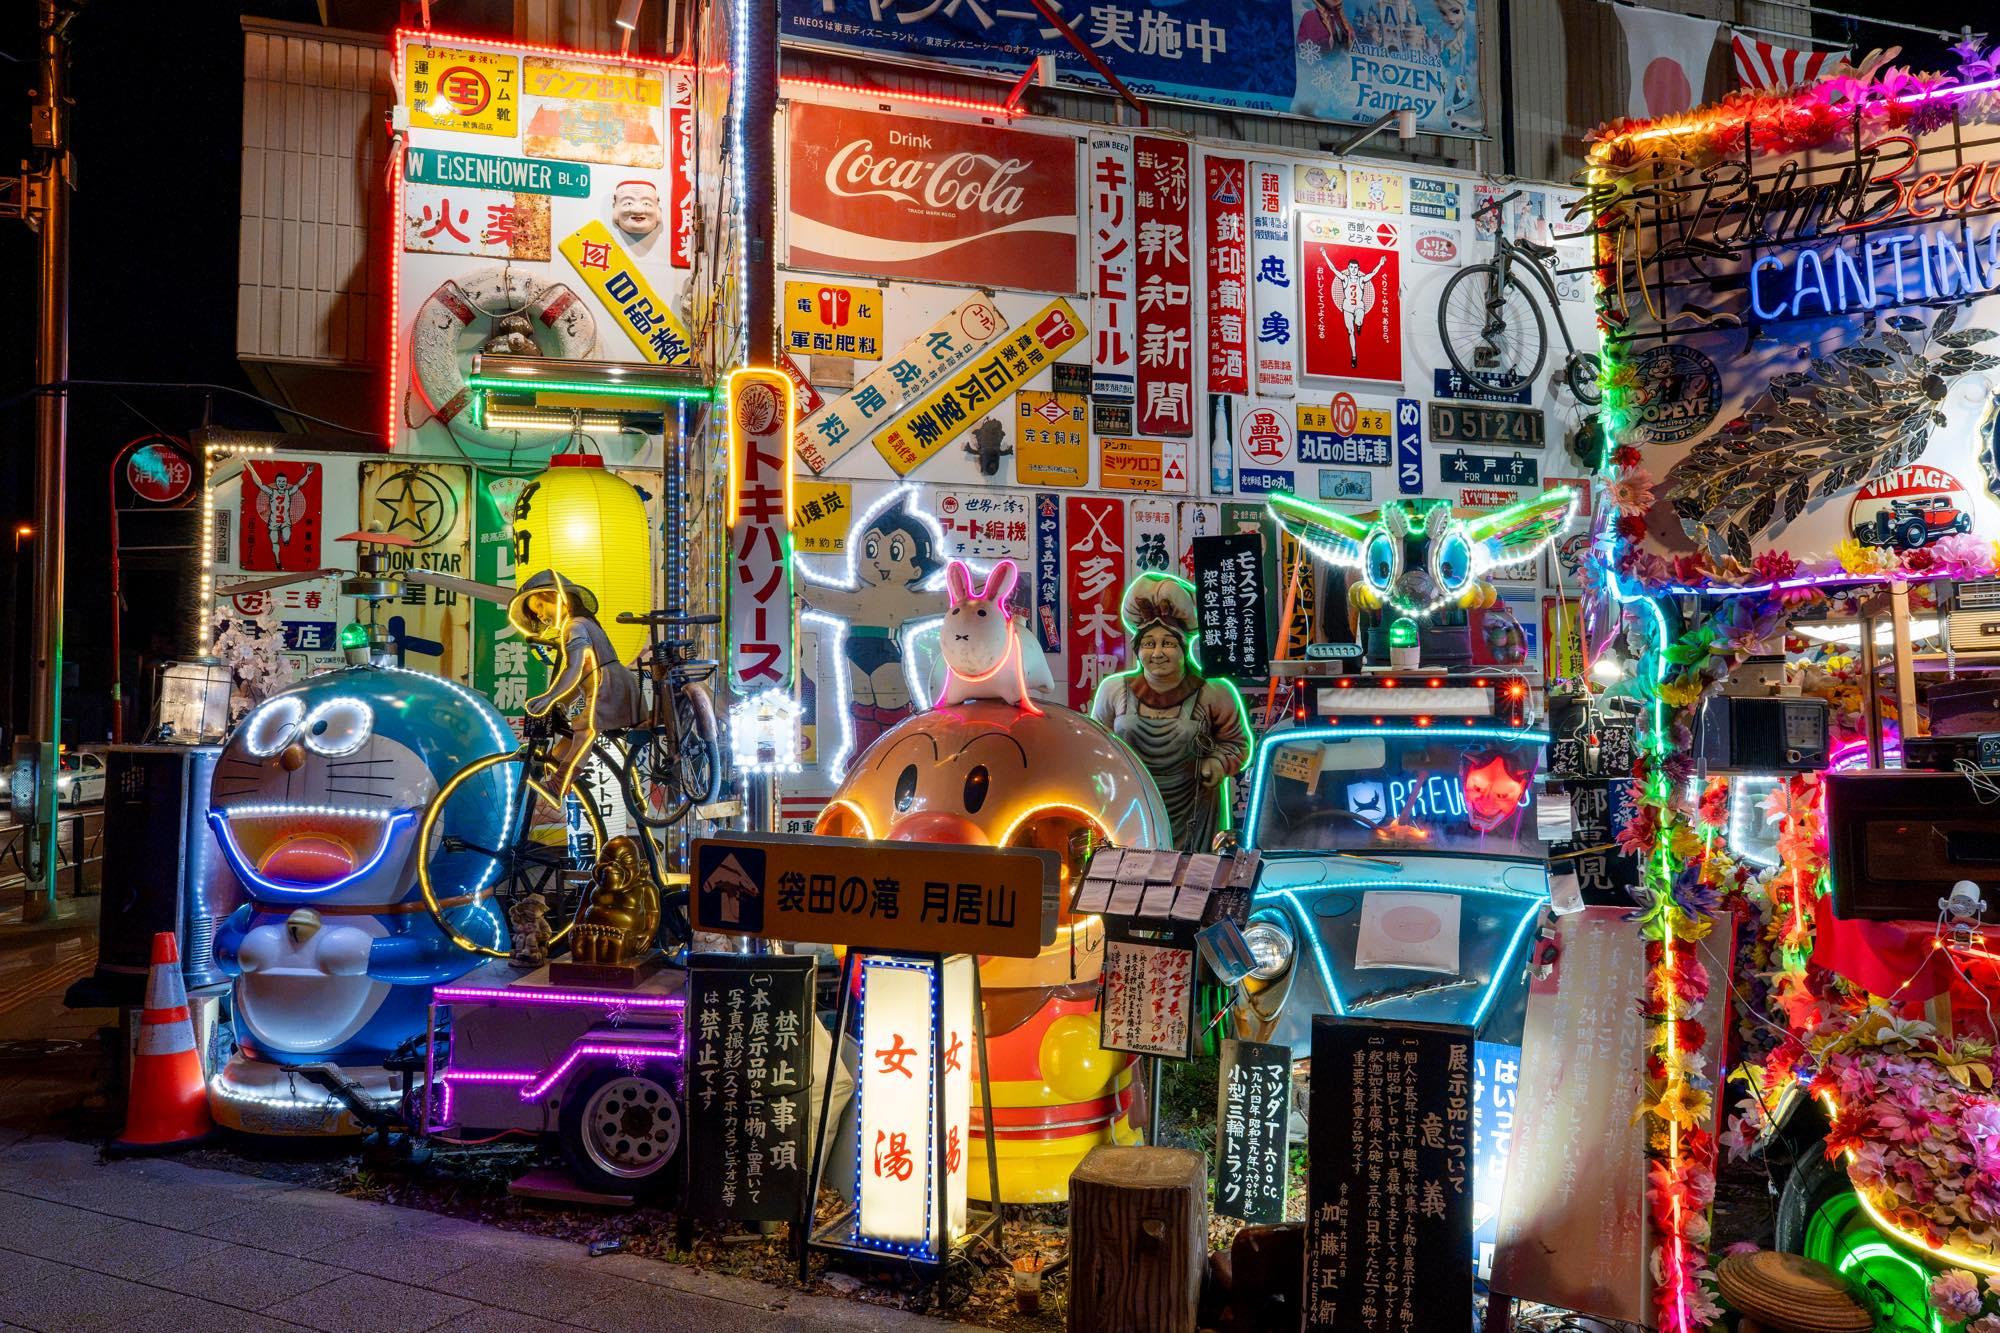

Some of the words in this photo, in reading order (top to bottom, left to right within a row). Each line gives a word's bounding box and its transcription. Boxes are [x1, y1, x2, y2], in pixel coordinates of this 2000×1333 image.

[1351, 39, 1389, 58] Anna
[1410, 49, 1442, 68] Elsa's
[414, 60, 429, 113] 運動靴
[535, 73, 649, 103] ダンプ出入口
[1350, 57, 1444, 95] FROZEN
[496, 69, 513, 121] ゴム靴
[1356, 82, 1438, 119] Fantasy
[889, 130, 932, 149] Drink
[1092, 140, 1110, 150] KIRIN
[1112, 141, 1129, 153] BEER
[407, 152, 424, 177] W
[437, 157, 552, 189] EISENHOWER
[825, 138, 1034, 215] Coca-Cola
[1137, 152, 1154, 208] 芸能
[1154, 153, 1169, 210] レジャー
[1171, 156, 1186, 212] スポーツ
[1355, 175, 1398, 188] オリエンタル
[1414, 180, 1442, 191] フルヤの
[1261, 173, 1280, 214] 銘酒
[1367, 201, 1401, 211] カレー
[1347, 222, 1375, 232] 西館へ
[1348, 232, 1373, 244] どうぞ
[1423, 239, 1449, 251] トリス
[1096, 157, 1129, 366] キリンビール
[798, 299, 812, 313] 電
[857, 304, 872, 319] 化
[1216, 211, 1243, 377] 銃印葡萄酒
[1257, 254, 1291, 346] 忠勇
[1316, 267, 1326, 339] おいしくてつよくなる
[1349, 284, 1358, 306] グリコ
[1138, 219, 1190, 425] 報知新聞
[791, 331, 877, 355] 軍配肥料
[816, 331, 955, 447] 化成肥料
[907, 356, 1014, 448] 石灰窒素
[1025, 428, 1080, 446] 完全飼料
[1362, 417, 1383, 430] ある
[796, 431, 827, 472] 特約店
[1104, 454, 1160, 472] ミツウロコ
[1302, 434, 1387, 464] 丸石の自転車
[1400, 404, 1420, 486] めぐろ
[1128, 479, 1158, 488] マメタン
[1454, 458, 1524, 474] 水戸行
[1465, 473, 1480, 482] FOR
[1494, 474, 1516, 483] MITO
[1866, 465, 1953, 498] VINTAGE
[275, 494, 286, 524] グリコ
[965, 498, 1024, 513] 世界に誇る
[805, 537, 844, 550] 特約店
[939, 518, 1026, 542] アート編機
[421, 553, 462, 573] STAR
[738, 441, 784, 682] トキハソース
[956, 543, 1011, 555] チェーン
[1204, 569, 1222, 647] 架空怪獣
[1220, 559, 1238, 663] 怪獣映画に登場する
[777, 871, 901, 920] 袋田の滝
[920, 881, 1016, 928] 月居山
[698, 991, 722, 1112] は禁止です
[769, 1010, 800, 1172] 禁止事項
[874, 1033, 917, 1182] 女湯
[1224, 1064, 1249, 1203] 小型三輪トラック
[1447, 1044, 1469, 1194] 展示品について
[1419, 1111, 1447, 1221] 意義
